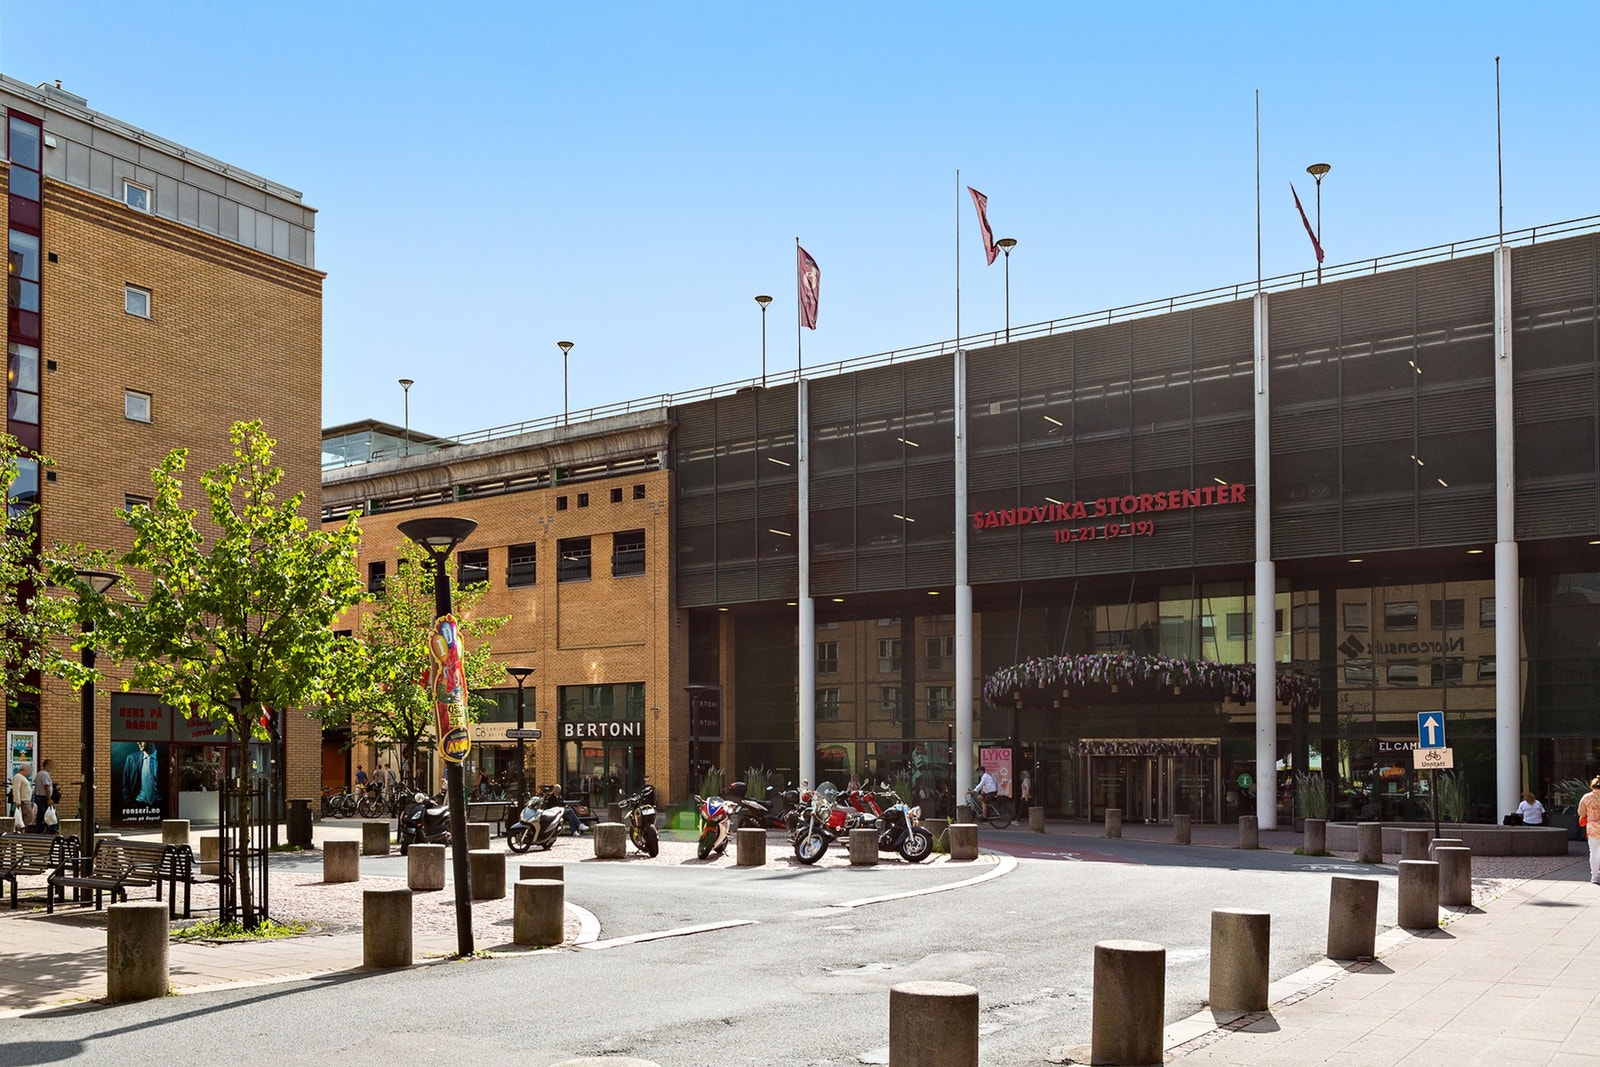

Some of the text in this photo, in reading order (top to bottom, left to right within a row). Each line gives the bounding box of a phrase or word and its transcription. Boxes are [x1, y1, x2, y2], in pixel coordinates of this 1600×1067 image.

[973, 483, 1247, 530] SANDVIKA STORSENTER
[1054, 519, 1155, 543] 10-21 (9-19)
[564, 722, 641, 737] BERTONI
[1379, 742, 1392, 751] EL
[122, 806, 161, 815] renseri.no
